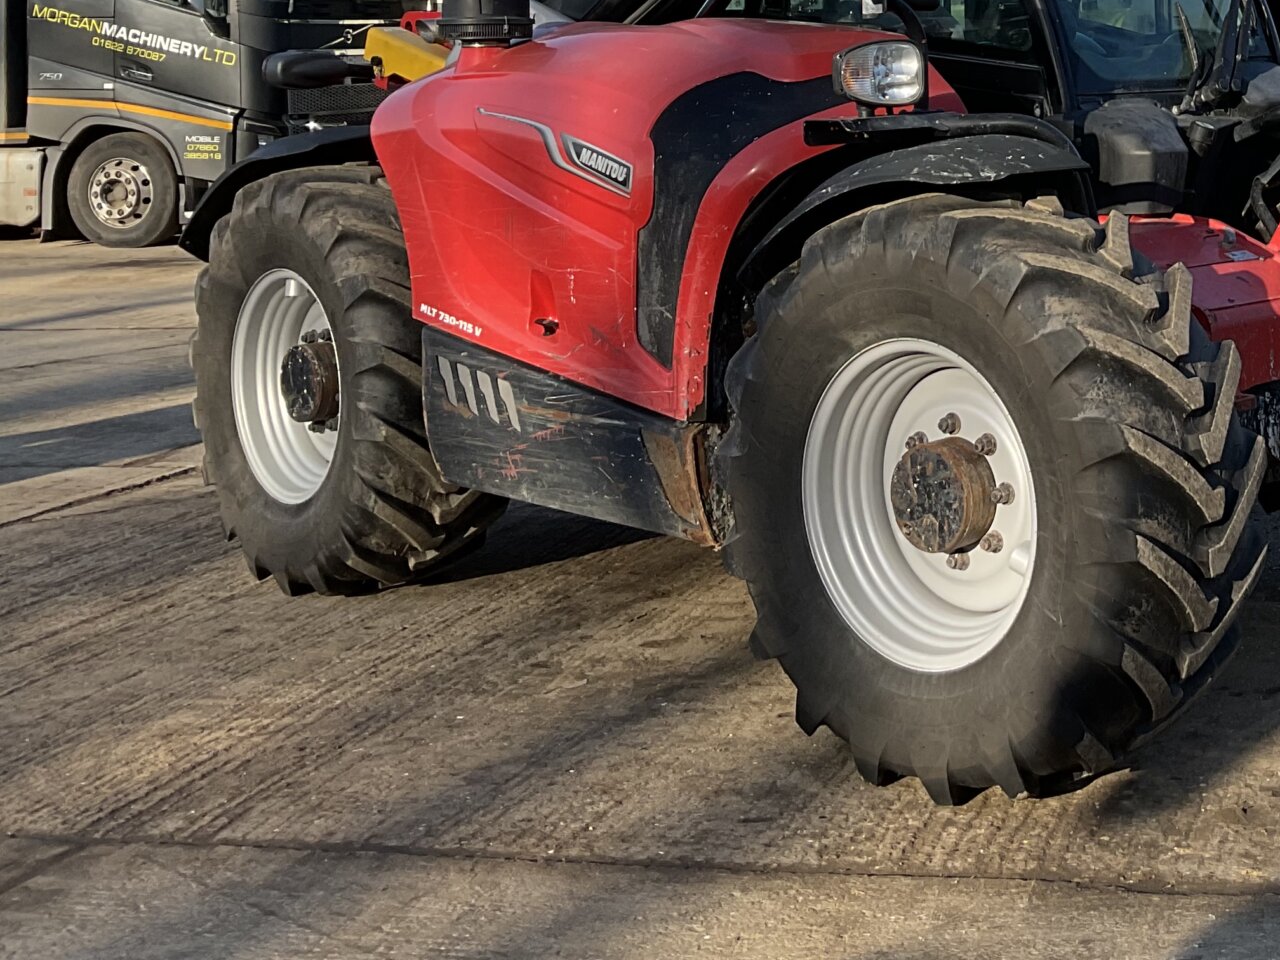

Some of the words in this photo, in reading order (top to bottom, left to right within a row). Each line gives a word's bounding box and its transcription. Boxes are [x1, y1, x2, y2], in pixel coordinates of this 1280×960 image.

[92, 36, 125, 53] 01622
[126, 45, 167, 62] 870087
[39, 72, 63, 81] 750
[185, 135, 221, 143] MOBILE
[580, 147, 627, 182] MANITOU
[420, 303, 437, 318] MLT
[438, 310, 473, 334] 730-115
[474, 326, 482, 337] V
